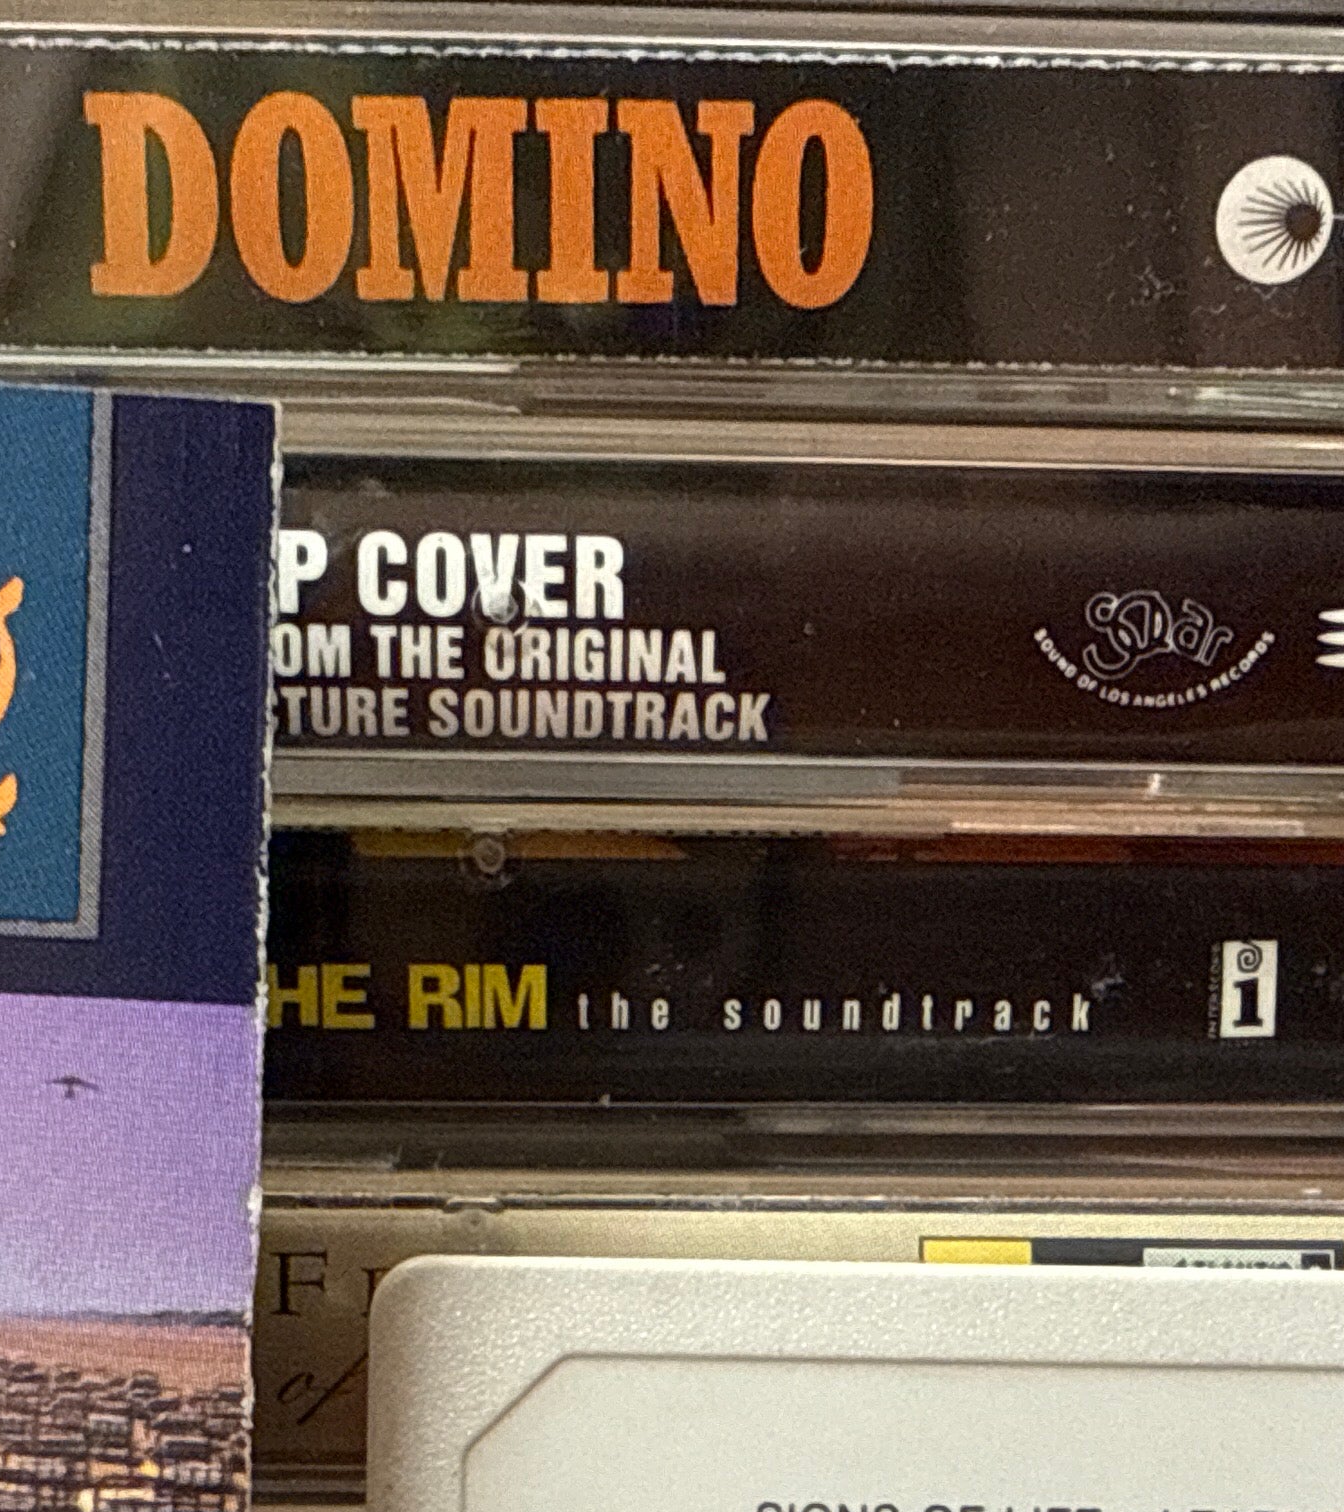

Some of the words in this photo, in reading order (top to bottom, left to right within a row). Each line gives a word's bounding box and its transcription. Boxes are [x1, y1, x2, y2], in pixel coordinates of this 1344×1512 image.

[83, 89, 874, 309] DOMINO
[357, 530, 625, 620] COVER
[371, 625, 465, 679] THE
[483, 628, 727, 684] ORIGINAL
[428, 690, 770, 742] SOUNDTRACK
[408, 963, 548, 1030] RIM
[578, 991, 670, 1030] the
[723, 992, 1090, 1031] soundtrack
